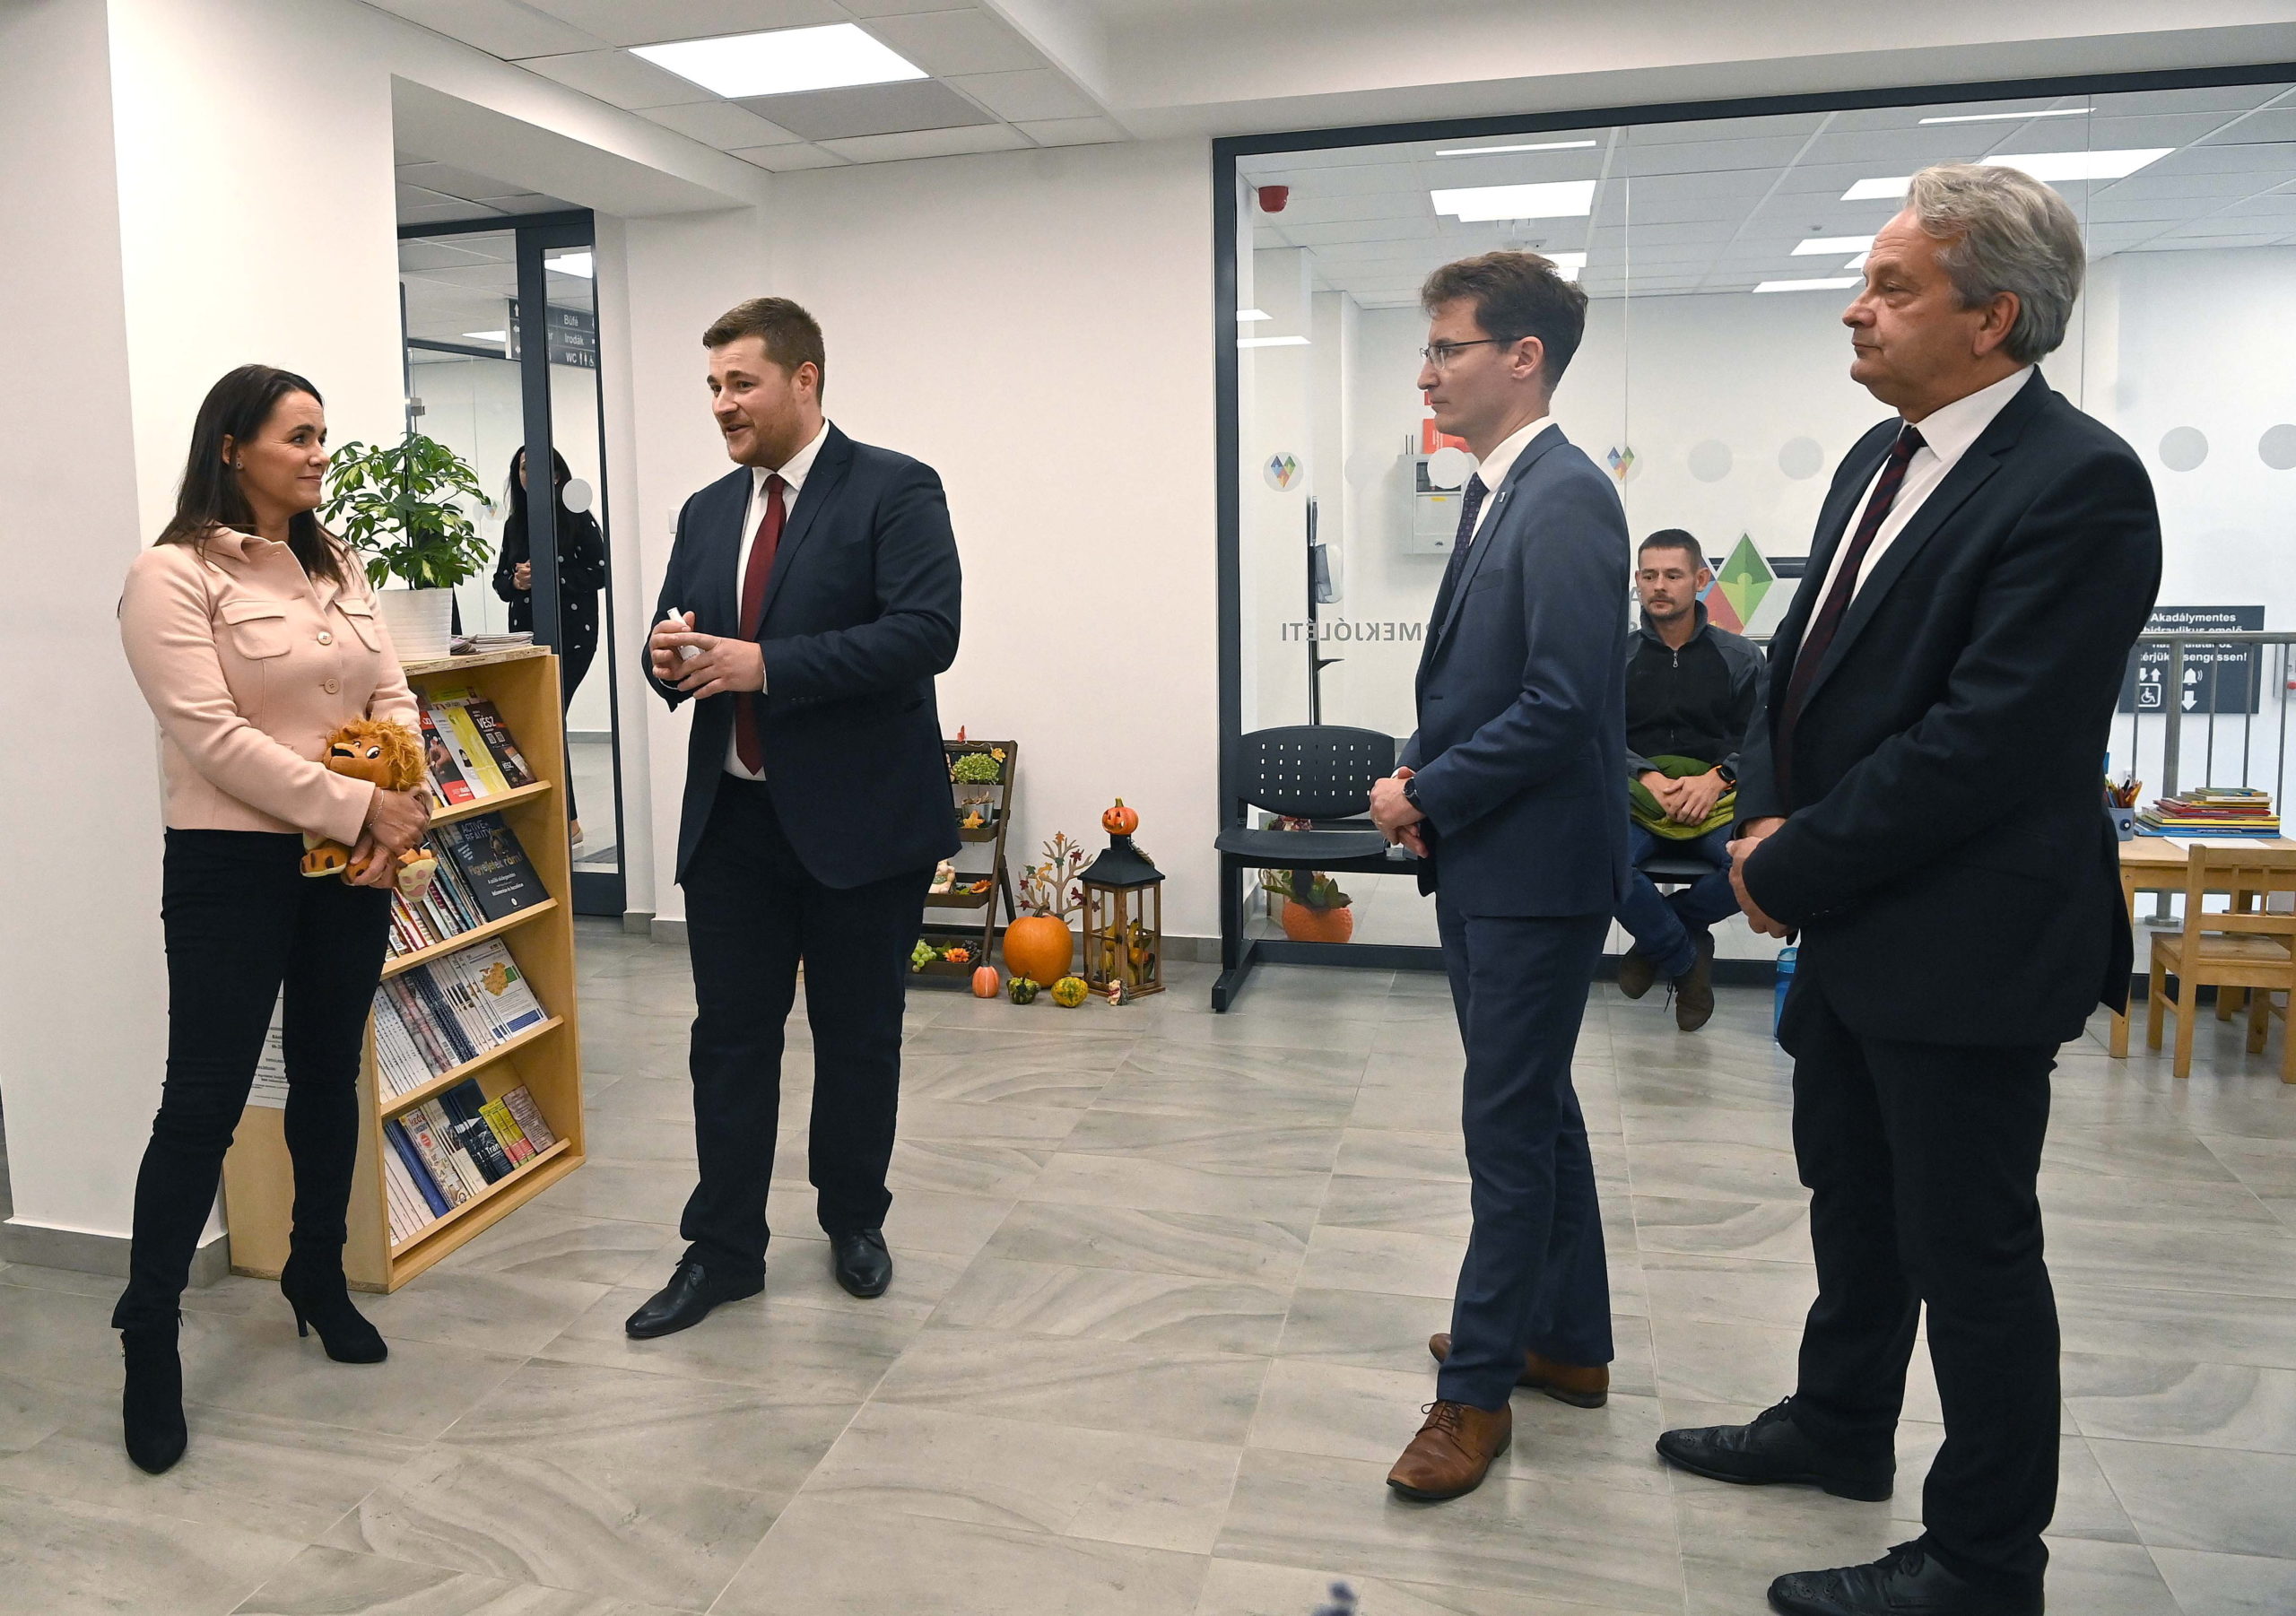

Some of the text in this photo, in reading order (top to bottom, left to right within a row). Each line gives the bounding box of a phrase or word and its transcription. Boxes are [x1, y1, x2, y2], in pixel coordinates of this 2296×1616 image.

[564, 314, 578, 326] Büfé
[564, 333, 584, 345] Irodák
[566, 352, 577, 363] WC
[2150, 613, 2237, 624] Akadálymentes
[2141, 652, 2247, 663] érjük sengssen!
[476, 716, 497, 729] VÉSZ
